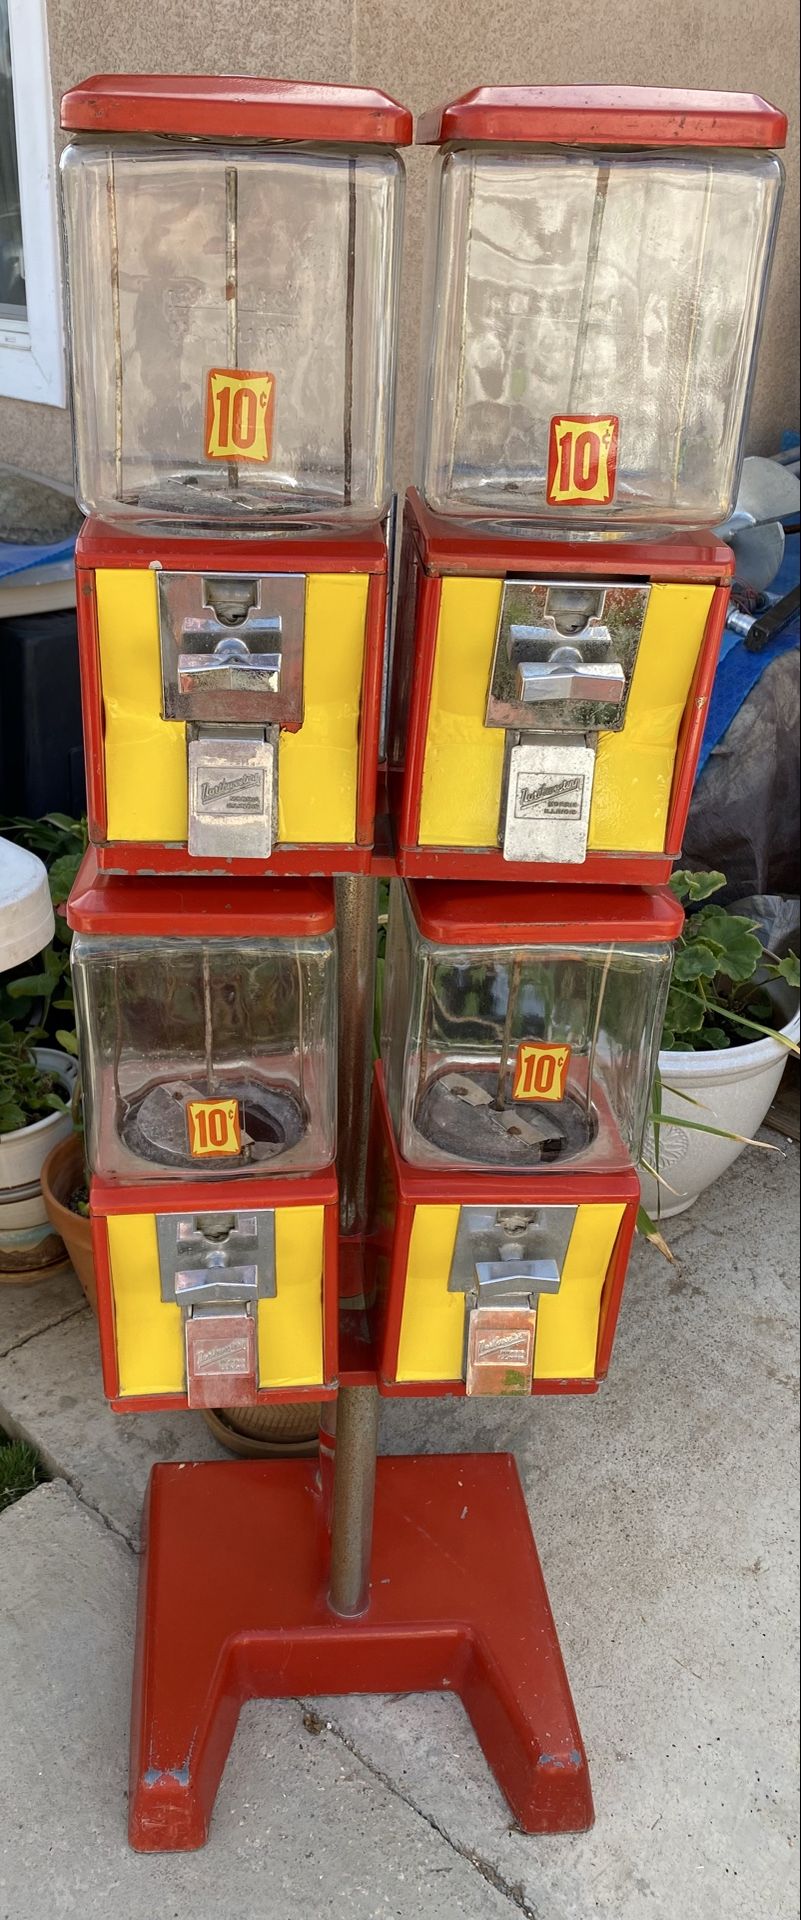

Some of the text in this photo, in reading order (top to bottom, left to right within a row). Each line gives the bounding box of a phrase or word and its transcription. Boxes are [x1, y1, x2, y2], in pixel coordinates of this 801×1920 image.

[216, 386, 267, 449] 10¢
[559, 429, 610, 491] 10¢
[523, 1054, 563, 1093] 10¢
